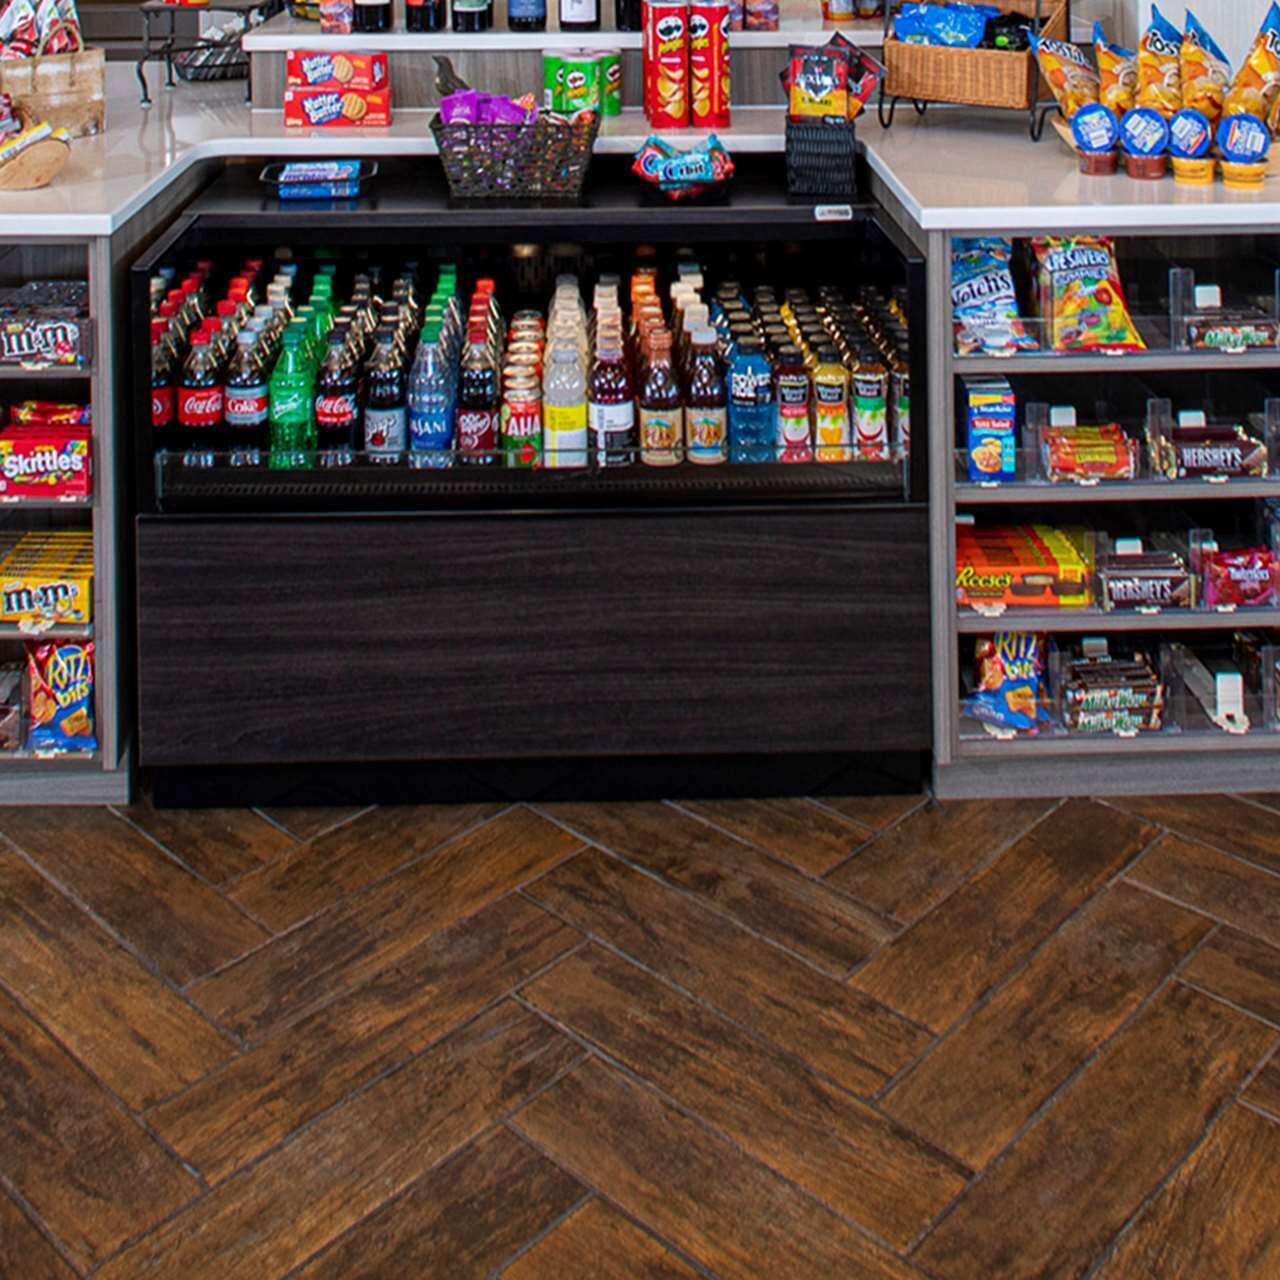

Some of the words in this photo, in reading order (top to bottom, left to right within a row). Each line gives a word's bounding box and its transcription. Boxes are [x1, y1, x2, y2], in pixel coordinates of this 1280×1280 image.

[227, 399, 259, 413] Coke
[507, 414, 541, 436] AHA
[3, 451, 84, 478] Skittles
[1183, 447, 1242, 468] HERSHEY'S
[1108, 577, 1170, 601] HERSHEY'S
[996, 631, 1038, 659] RITZ
[48, 650, 92, 690] RITZ
[56, 682, 90, 710] bits
